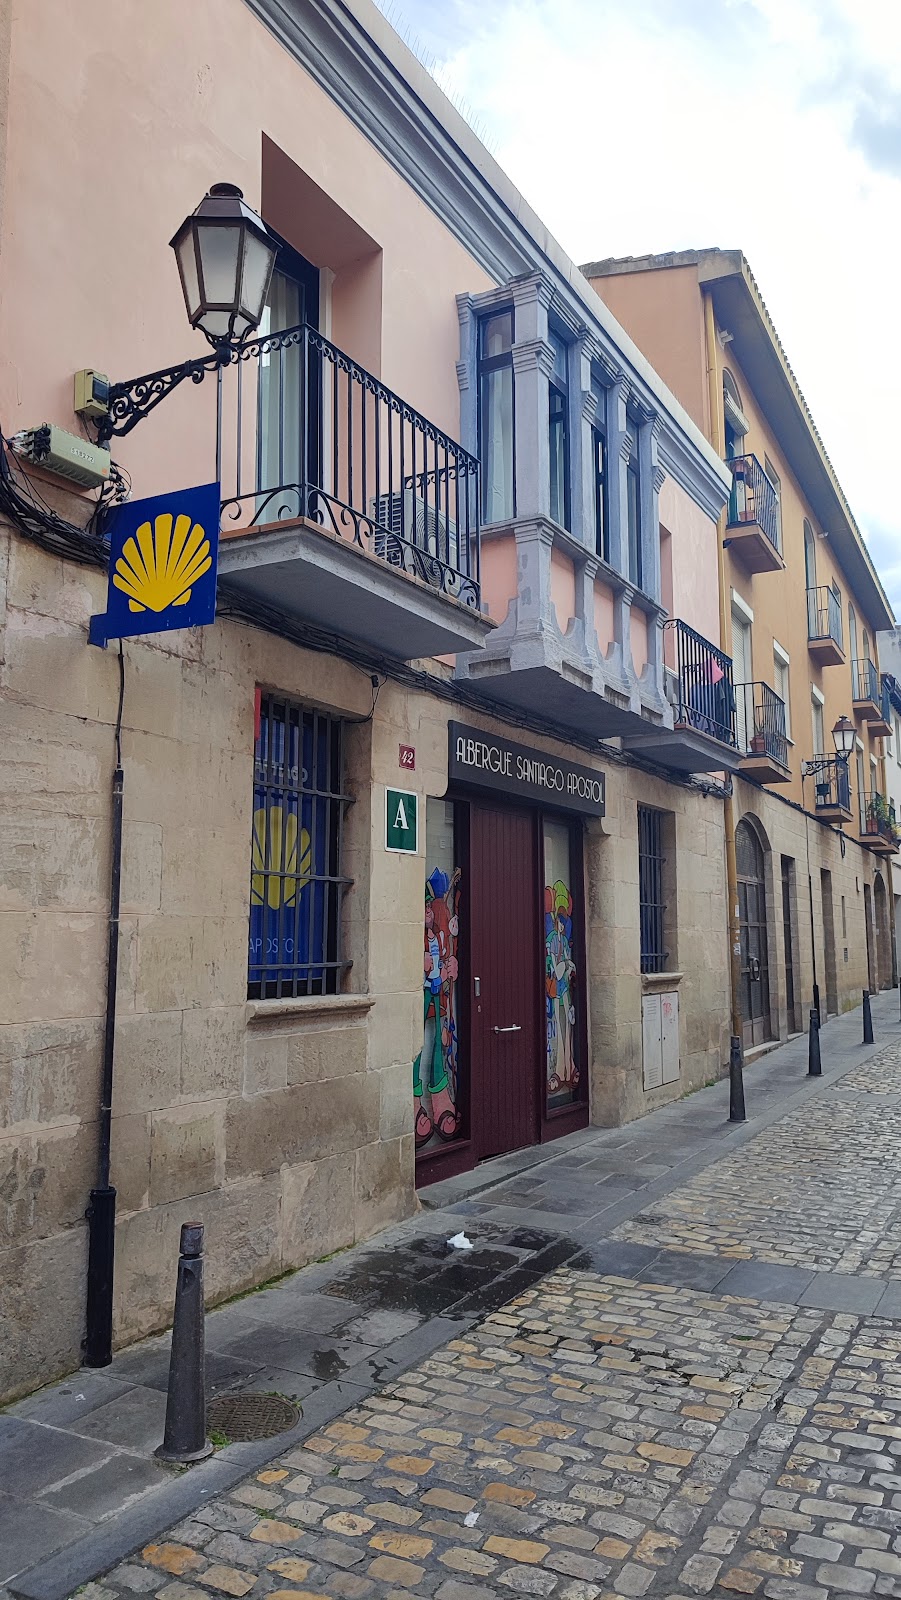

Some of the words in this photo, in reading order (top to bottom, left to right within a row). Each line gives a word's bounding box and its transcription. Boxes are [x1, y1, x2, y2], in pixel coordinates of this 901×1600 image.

[401, 750, 414, 764] 42
[456, 736, 513, 777] ALBERGUE
[516, 755, 565, 792] SANTIAGO
[567, 772, 604, 804] APOSTOL
[392, 798, 410, 830] A
